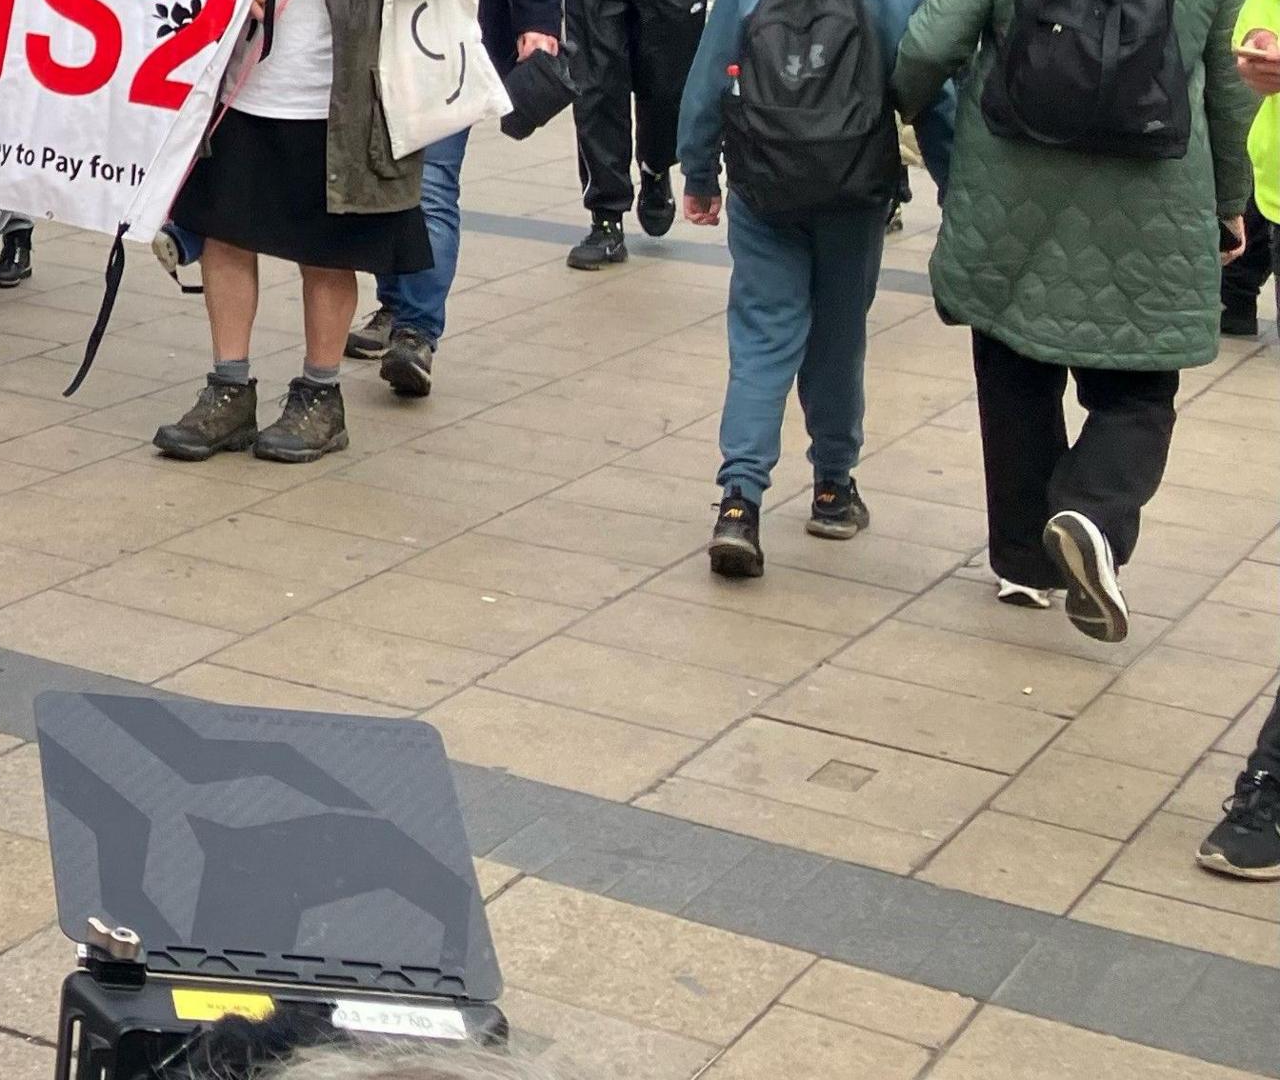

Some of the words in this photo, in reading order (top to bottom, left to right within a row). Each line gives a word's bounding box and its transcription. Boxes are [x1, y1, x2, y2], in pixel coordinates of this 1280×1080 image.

[16, 143, 35, 166] to
[41, 146, 83, 182] Pay
[90, 154, 125, 183] for
